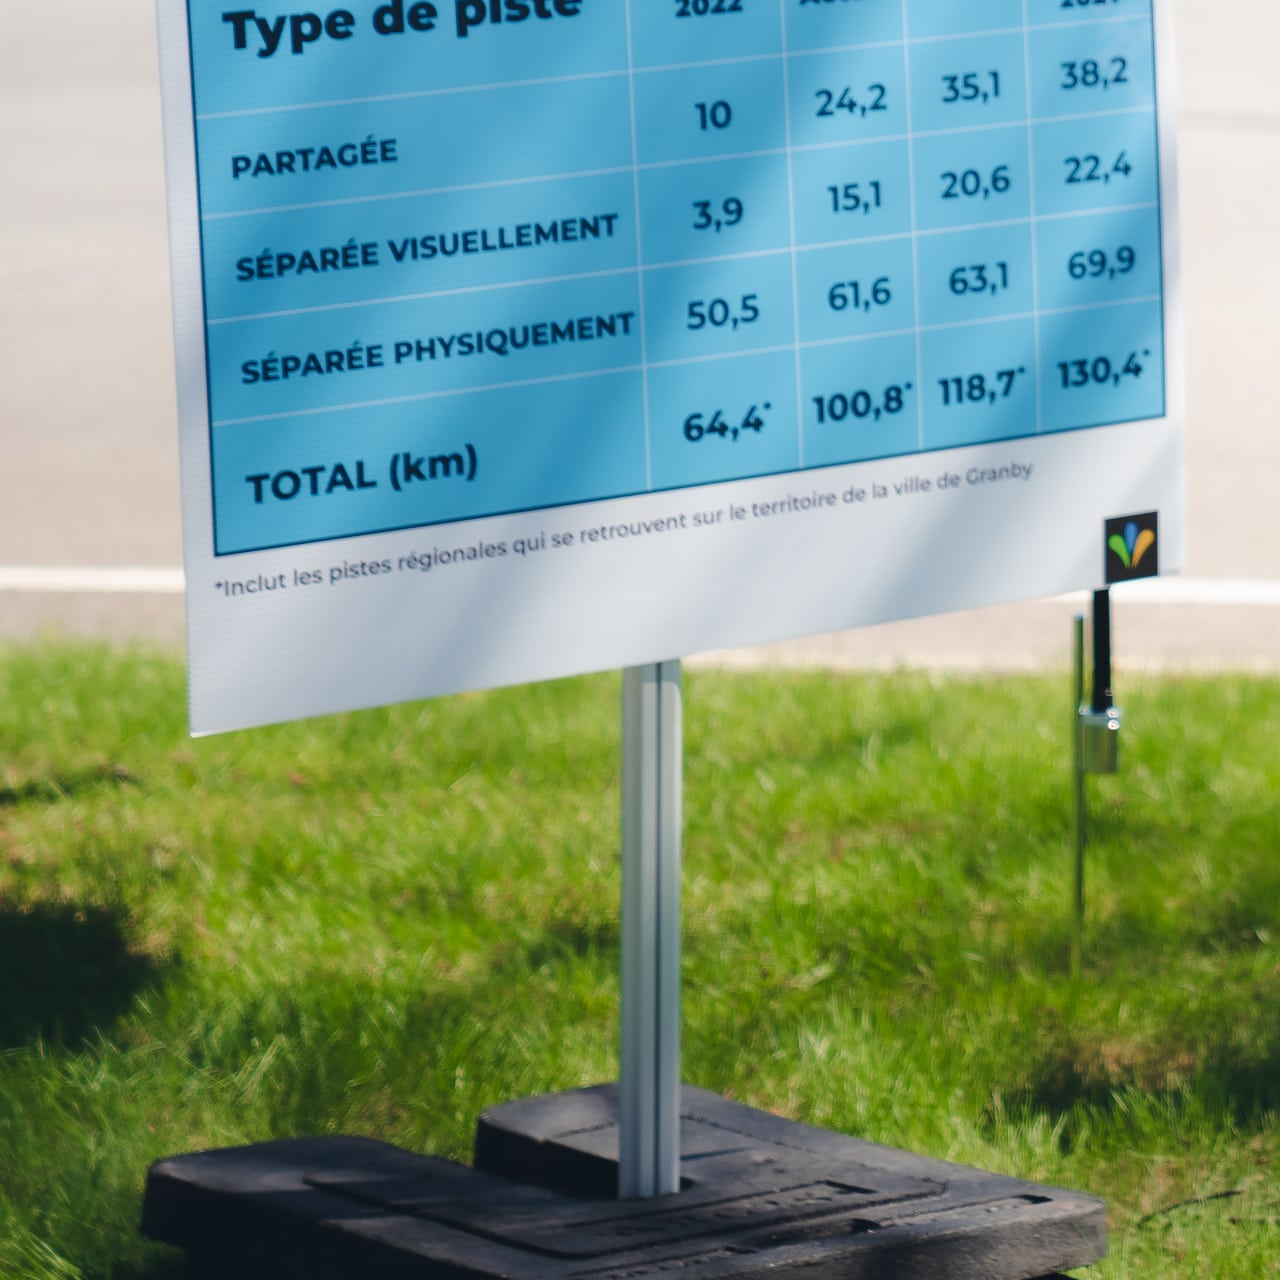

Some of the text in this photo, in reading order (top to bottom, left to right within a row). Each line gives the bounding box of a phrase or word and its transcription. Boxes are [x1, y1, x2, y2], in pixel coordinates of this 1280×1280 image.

[221, 9, 355, 58] Type
[941, 71, 1001, 105] 35,1
[1060, 57, 1128, 91] 38,2
[694, 100, 733, 131] 10
[814, 83, 887, 119] 24,2
[231, 134, 398, 179] PARTAGÉE
[1063, 151, 1132, 186] 22,4
[827, 180, 881, 214] 15,1
[940, 165, 1010, 200] 20,6
[692, 197, 744, 233] 3,9
[236, 212, 619, 282] SÉPARÉE VISUELLEMENT
[1068, 245, 1136, 280] 69,9
[828, 277, 891, 312] 61,6
[949, 262, 1008, 297] 63,1
[686, 294, 760, 331] 50,5
[241, 311, 636, 384] SÉPARÉE PHYSIQUEMENT
[246, 443, 477, 504] TOTAL (km)
[293, 567, 323, 586] les
[329, 559, 392, 586] pistes
[398, 540, 507, 572] régionales
[513, 531, 545, 556] qui
[550, 531, 574, 547] se
[580, 513, 687, 541] retrouvent
[692, 510, 723, 526] sur
[729, 504, 747, 521] le
[752, 490, 837, 518] territoire
[842, 485, 866, 504] de
[872, 482, 888, 499] la
[892, 476, 932, 495] ville
[936, 471, 961, 489] de
[965, 461, 1033, 486] Granby
